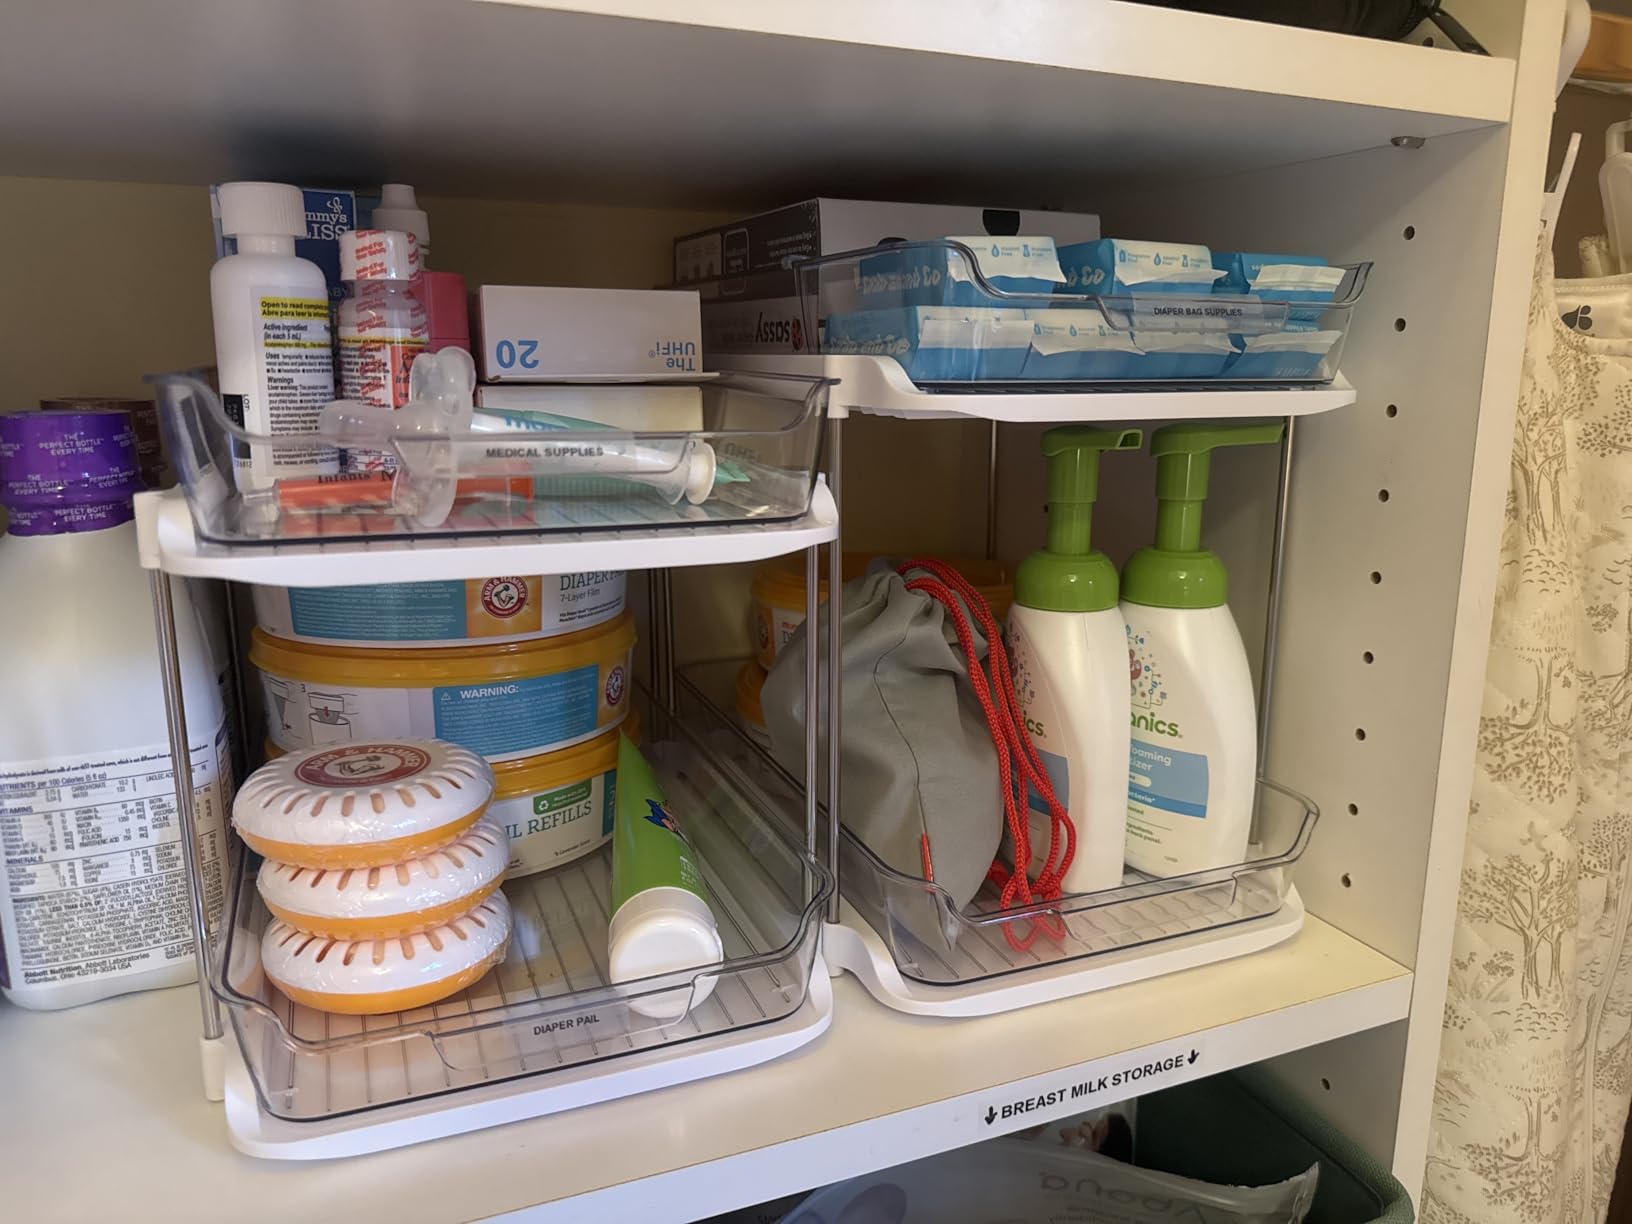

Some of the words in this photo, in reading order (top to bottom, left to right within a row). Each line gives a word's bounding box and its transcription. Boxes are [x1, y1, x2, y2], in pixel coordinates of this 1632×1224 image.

[1154, 307, 1184, 316] DIAPER
[1186, 308, 1202, 316] BAG
[1204, 308, 1243, 317] SUPPLIES
[756, 312, 791, 343] sassy
[496, 340, 540, 368] 20
[656, 342, 696, 356] UHFi
[666, 357, 696, 371] The
[40, 440, 74, 450] PERFECT
[75, 438, 101, 448] BOTTLE
[50, 448, 77, 456] EVERY
[486, 448, 540, 458] MEDICAL
[544, 447, 604, 458] SUPPLIES
[39, 479, 68, 488] BOTTLE
[54, 508, 86, 516] PERFECT
[86, 504, 113, 514] BOTTLE
[64, 514, 87, 522] EVERY
[560, 571, 609, 591] DIAPER
[484, 582, 494, 602] ARM
[500, 576, 526, 599] HAMMER
[560, 591, 586, 602] 7-Layer
[587, 588, 600, 597] Film
[460, 685, 520, 700] WARNING:
[1130, 711, 1179, 738] anics
[306, 754, 338, 770] ARM
[1130, 746, 1172, 767] oaming
[1131, 757, 1153, 772] izer
[61, 776, 84, 784] Calories
[506, 824, 522, 838] IL
[528, 800, 592, 835] REFILLS
[6, 856, 44, 864] MINERALS
[24, 970, 48, 978] Abbott
[86, 960, 106, 968] Abbott
[108, 953, 150, 965] Laboratories
[534, 1019, 574, 1036] DIAPER
[576, 1014, 600, 1027] PAIL
[1000, 1088, 1067, 1120] BREAST
[1070, 1076, 1109, 1100] MILK
[1111, 1054, 1185, 1086] STORAGE
